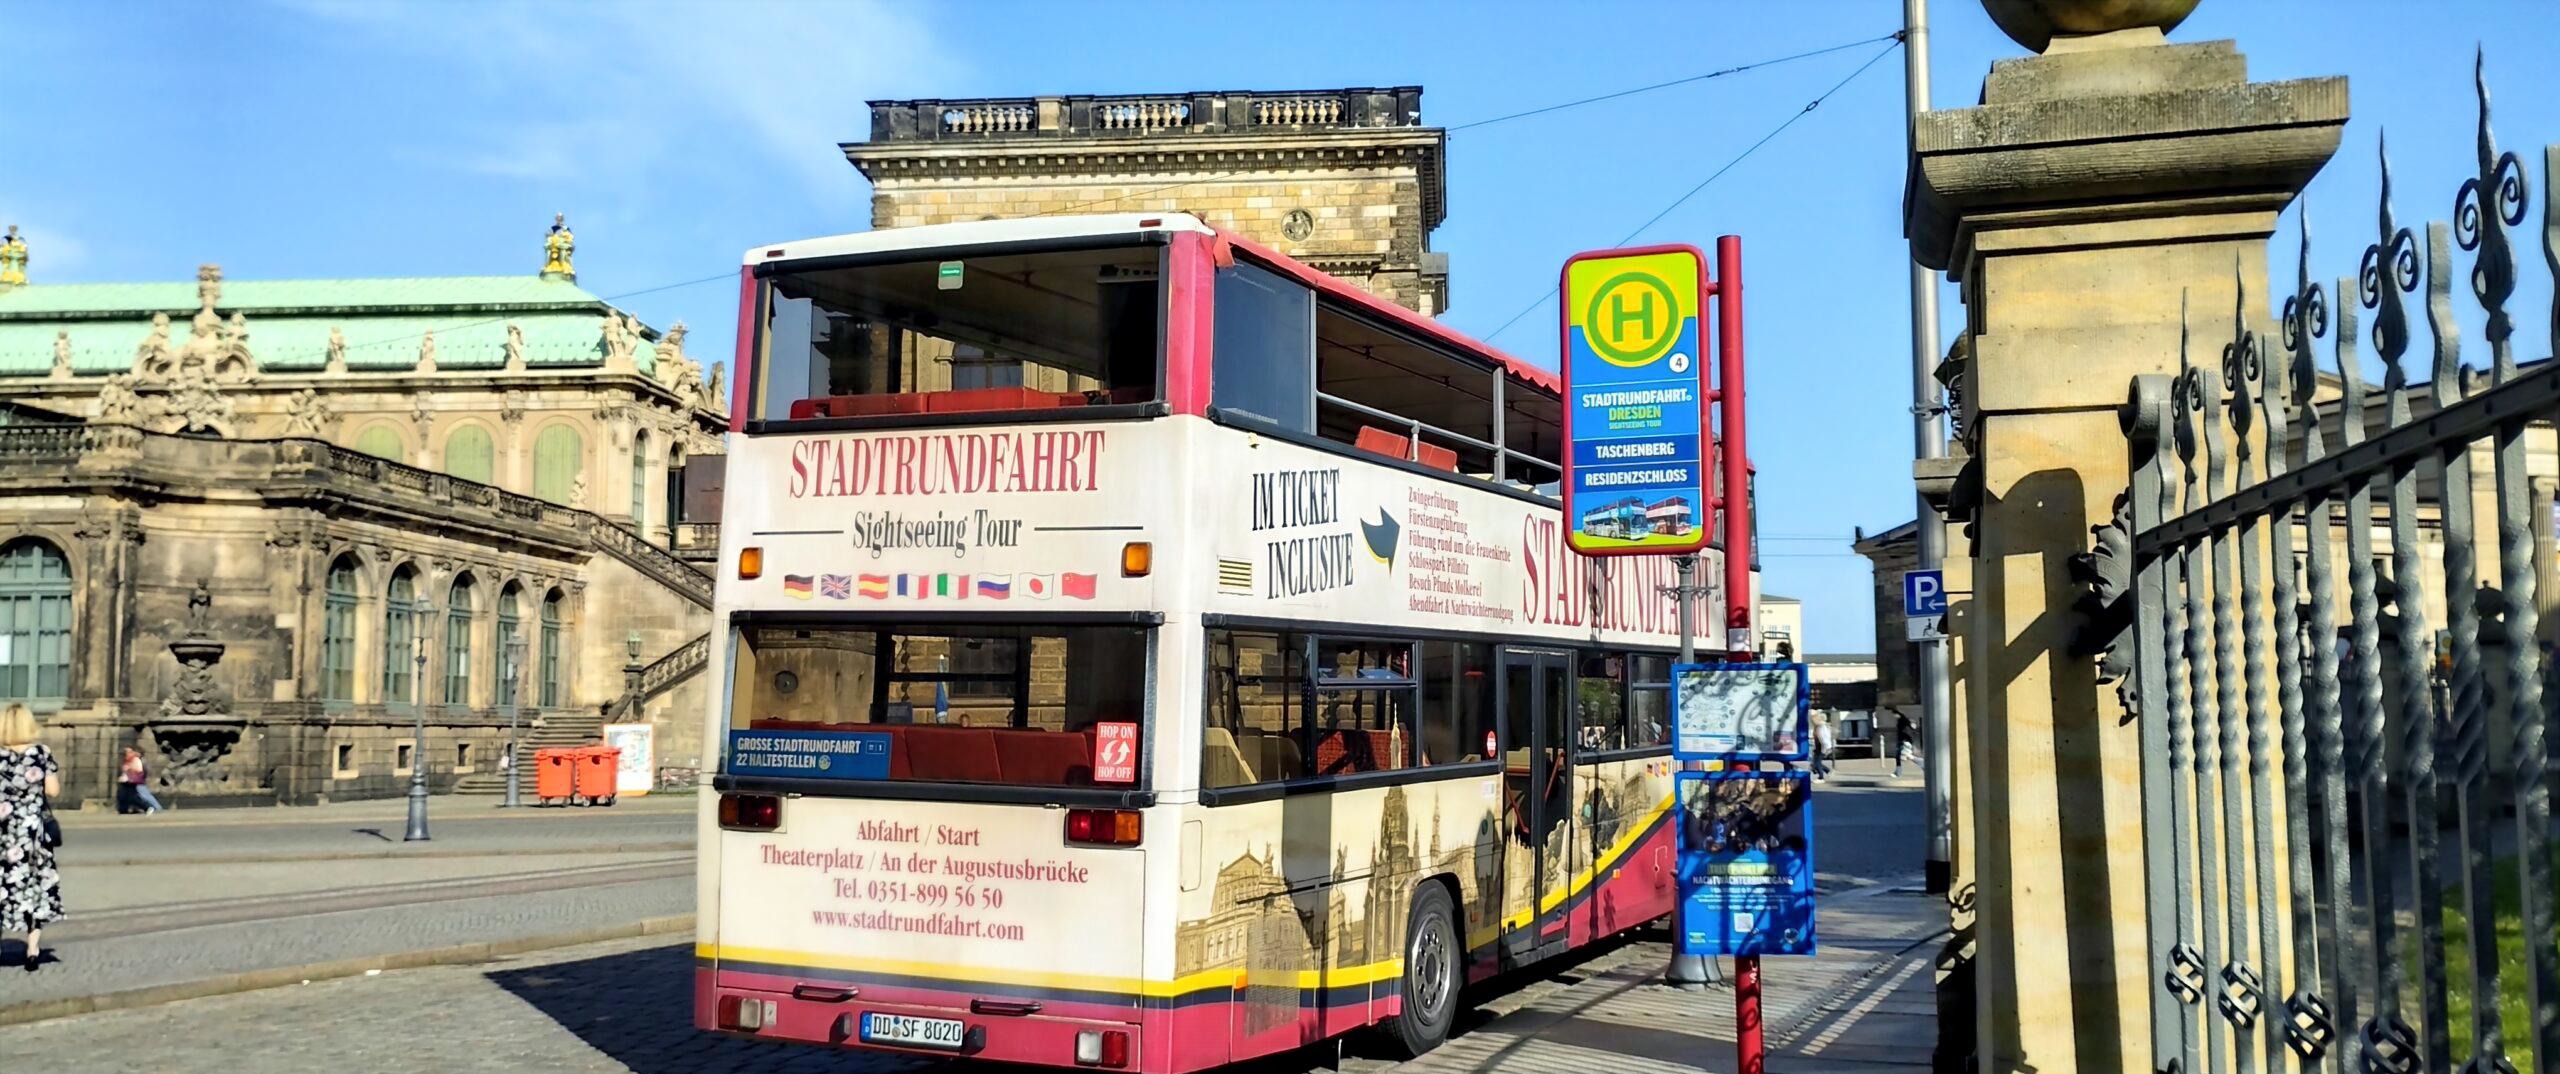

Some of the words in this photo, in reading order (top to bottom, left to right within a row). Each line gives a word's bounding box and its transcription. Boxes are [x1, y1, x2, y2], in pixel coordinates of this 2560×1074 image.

[1675, 357, 1682, 368] 4
[1608, 405, 1661, 421] DRESDEN
[1595, 442, 1675, 458] TASCHENBERG
[789, 430, 1105, 498] STADTRUNDFAHRT
[1585, 469, 1687, 486] RESIDENZSCHLOSS
[1252, 473, 1274, 531] IM
[1279, 467, 1340, 528] TICKET
[1409, 486, 1459, 516] Zwingerführung
[853, 511, 968, 559] Sightseeing
[974, 509, 1022, 547] Tour
[1409, 529, 1437, 554] Führung
[1438, 536, 1453, 553] rund
[1454, 541, 1464, 554] um
[1465, 539, 1475, 556] die
[1477, 542, 1511, 562] Frauenkirche
[1268, 533, 1354, 599] INCLUSIVE
[1409, 551, 1446, 575] Schlosspark
[1409, 573, 1431, 591] Besuch
[1455, 579, 1482, 597] Molkerei
[1914, 576, 1938, 610] P
[1409, 593, 1444, 614] Abendfahrt
[1445, 599, 1450, 614] &
[1100, 725, 1119, 738] HOP
[1120, 726, 1133, 739] ON
[737, 737, 772, 751] GROSSE
[774, 738, 861, 754] STADTRUNDFAHRT
[736, 753, 748, 766] 22
[749, 753, 816, 768] HALTESTELLEN
[1098, 766, 1115, 777] HOP
[1116, 767, 1132, 778] OFF
[856, 820, 920, 843] Abfahrt
[924, 824, 933, 846] /
[937, 824, 981, 847] Start
[761, 844, 864, 874] Theaterplatz
[868, 850, 877, 872] /
[880, 852, 901, 873] An
[907, 851, 937, 875] der
[942, 854, 1089, 884] Augustusbrücke
[834, 877, 862, 899] Tel.
[868, 880, 948, 907] 0351-899
[954, 884, 975, 907] 56
[982, 887, 1003, 910] 50
[812, 908, 1024, 942] www.stadtrundfahrt.com
[873, 1016, 891, 1035] DD
[902, 1018, 921, 1038] SF
[924, 1020, 961, 1042] 8020
